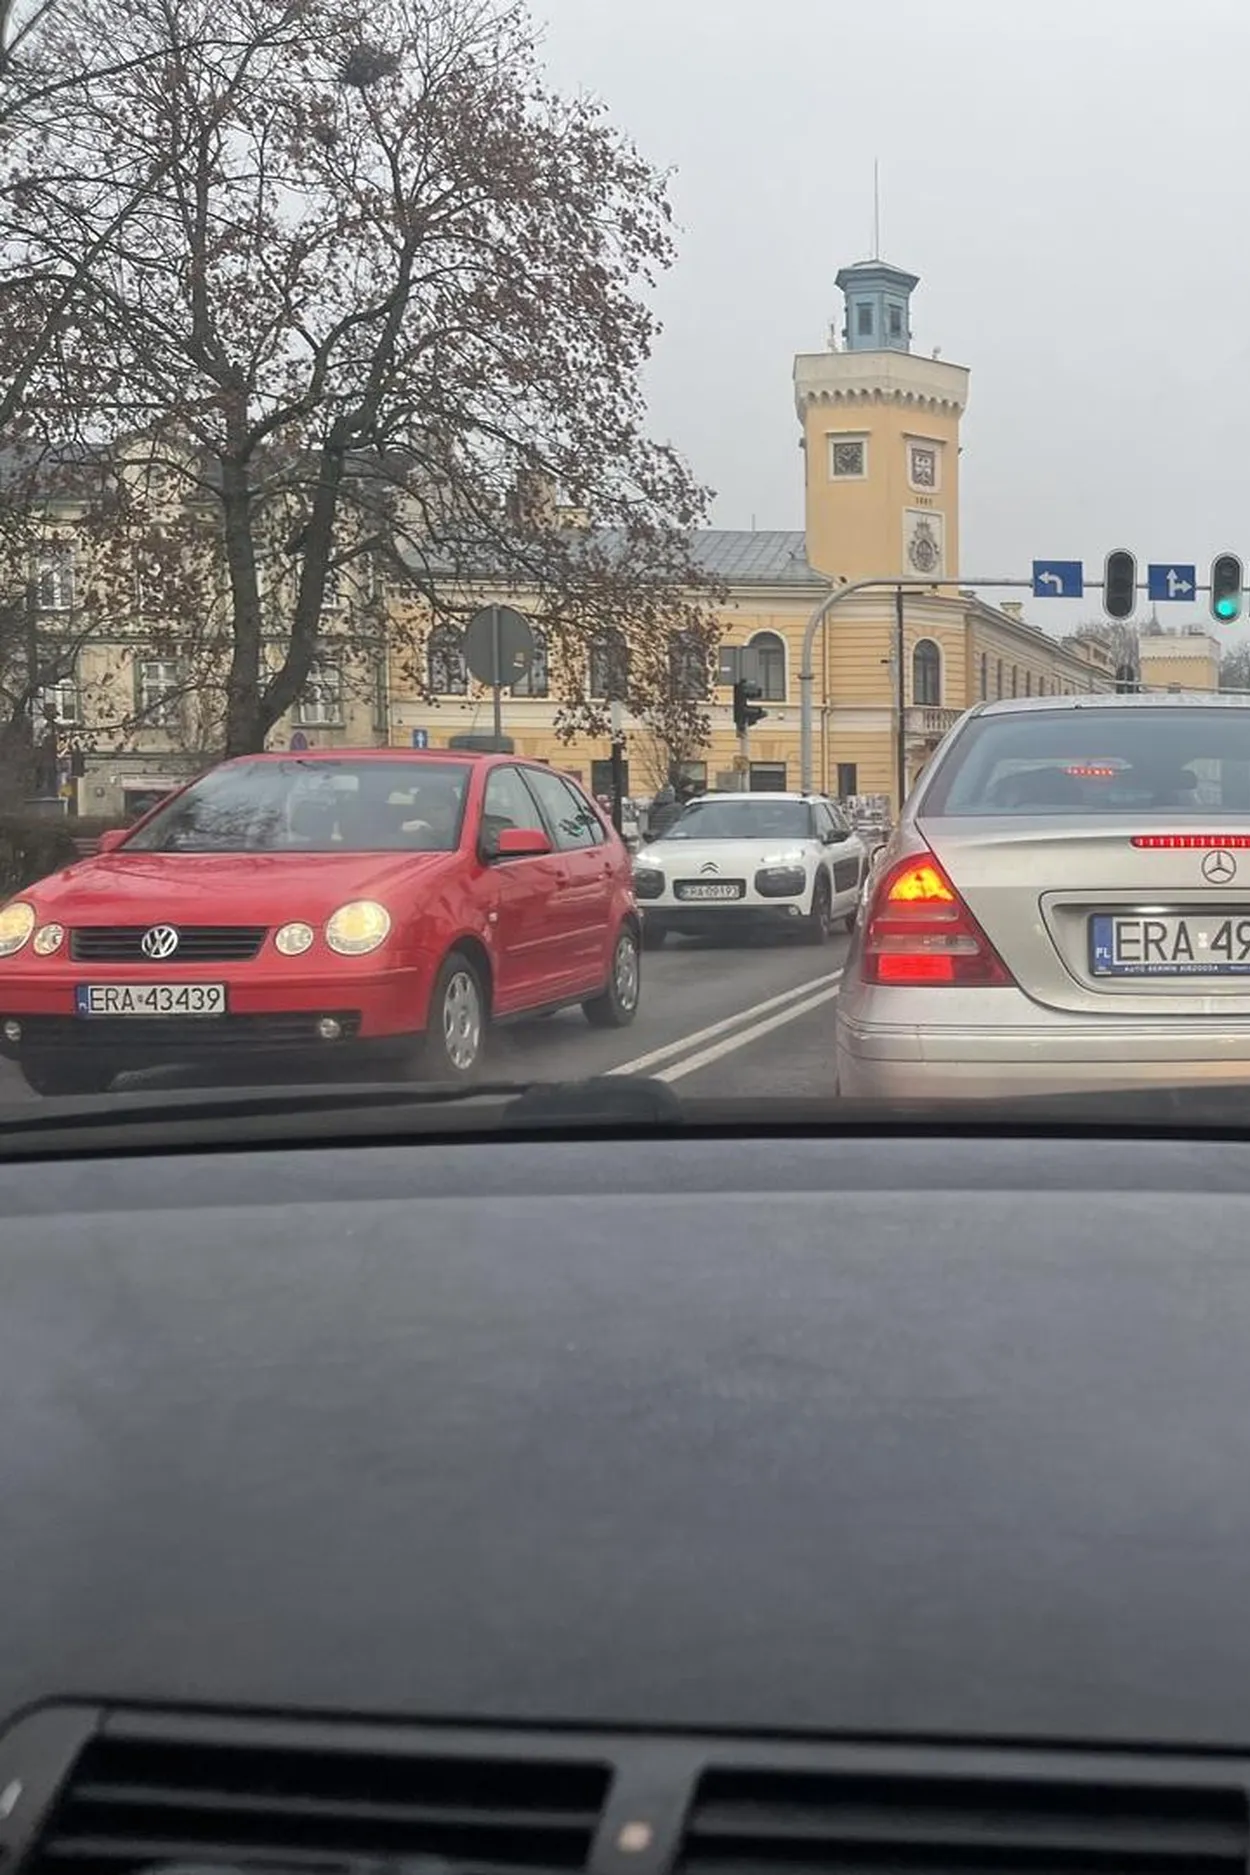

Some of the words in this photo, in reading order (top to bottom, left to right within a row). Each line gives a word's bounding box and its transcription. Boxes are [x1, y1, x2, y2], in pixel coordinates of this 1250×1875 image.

[1116, 920, 1194, 961] ERA
[90, 987, 135, 1011] ERA
[145, 987, 221, 1011] 43439
